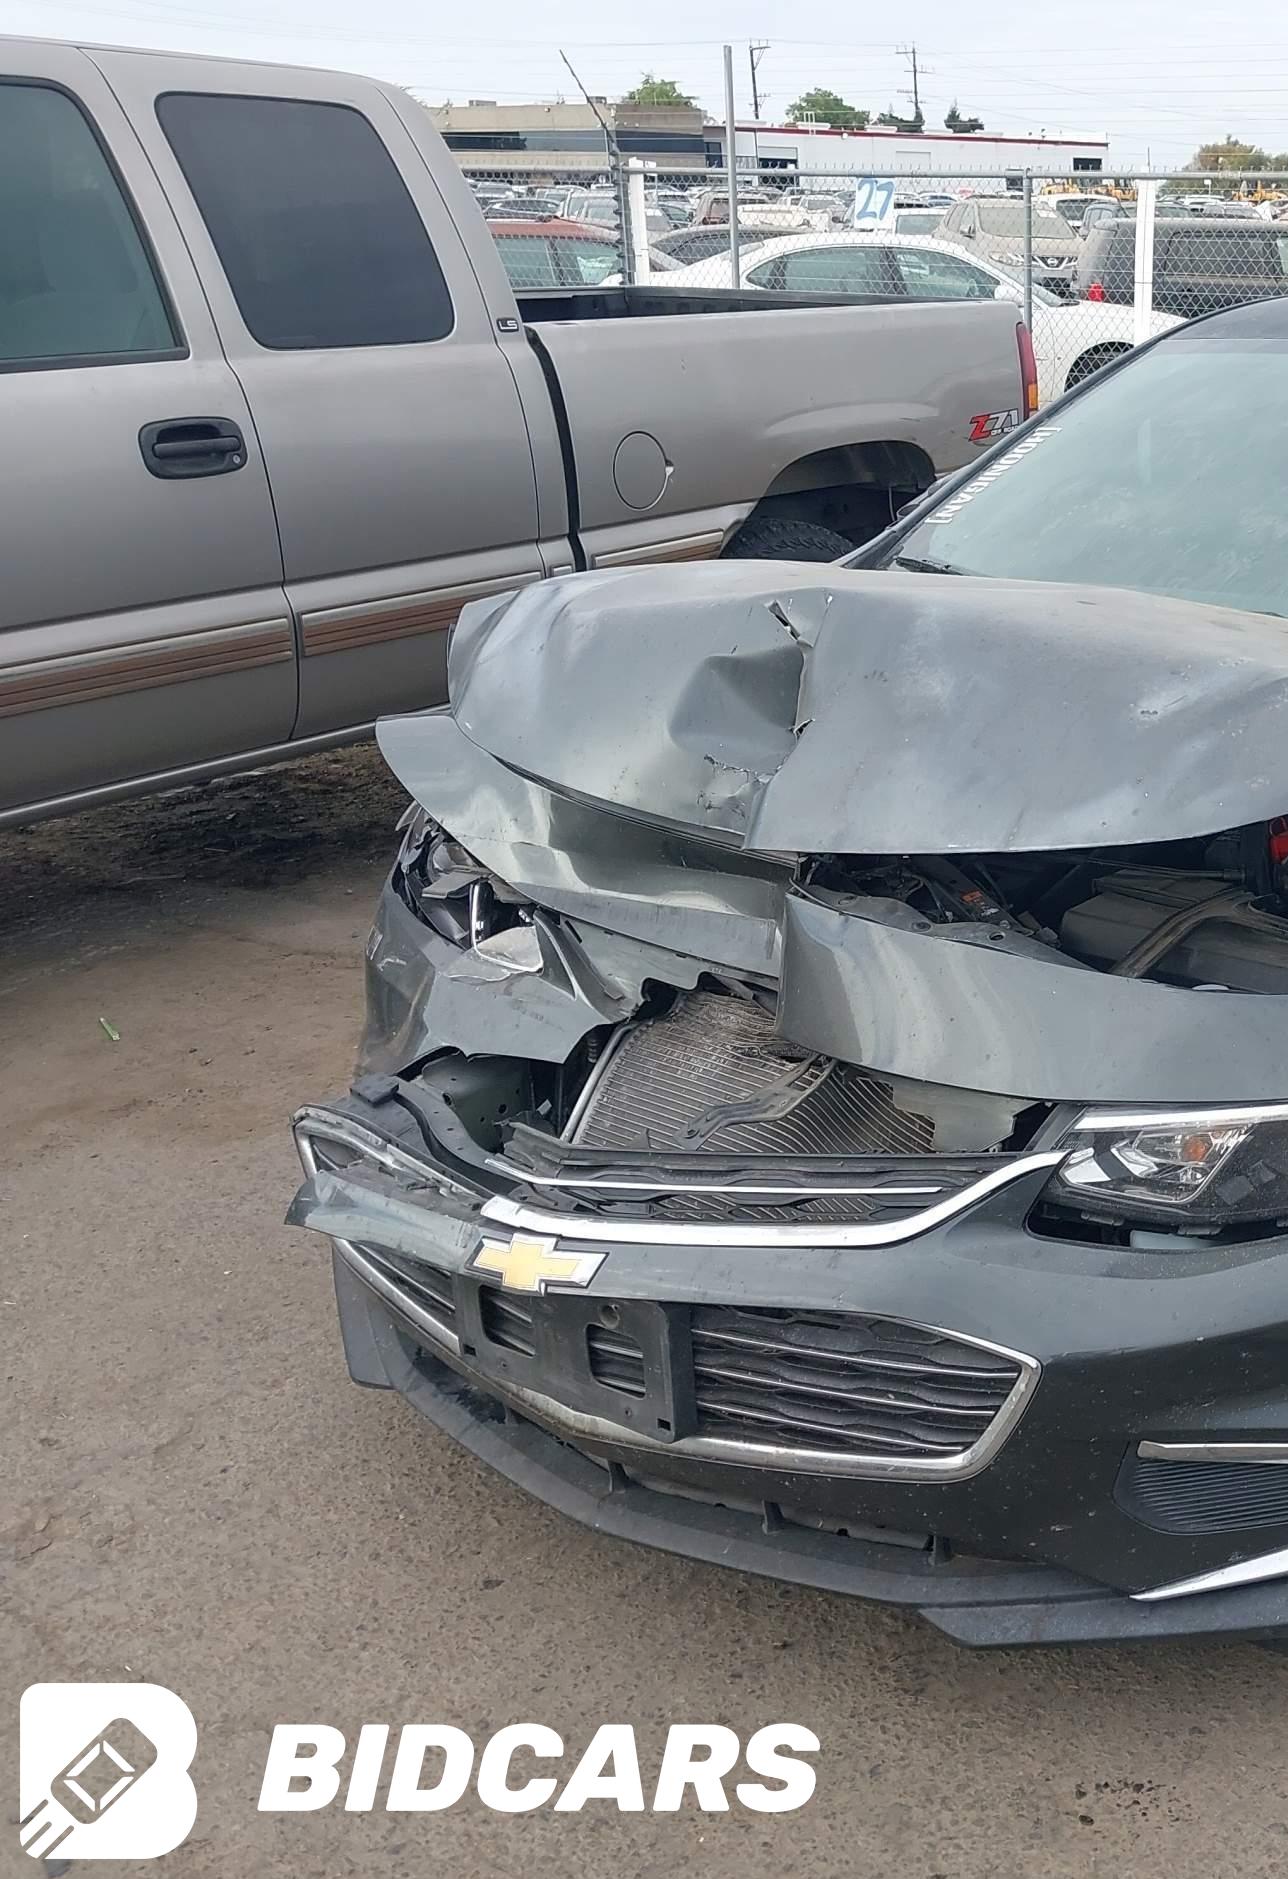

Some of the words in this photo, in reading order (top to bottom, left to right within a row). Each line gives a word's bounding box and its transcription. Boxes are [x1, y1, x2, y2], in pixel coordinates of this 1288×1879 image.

[857, 178, 894, 221] 27
[498, 320, 518, 330] LS
[968, 408, 1019, 441] Z71
